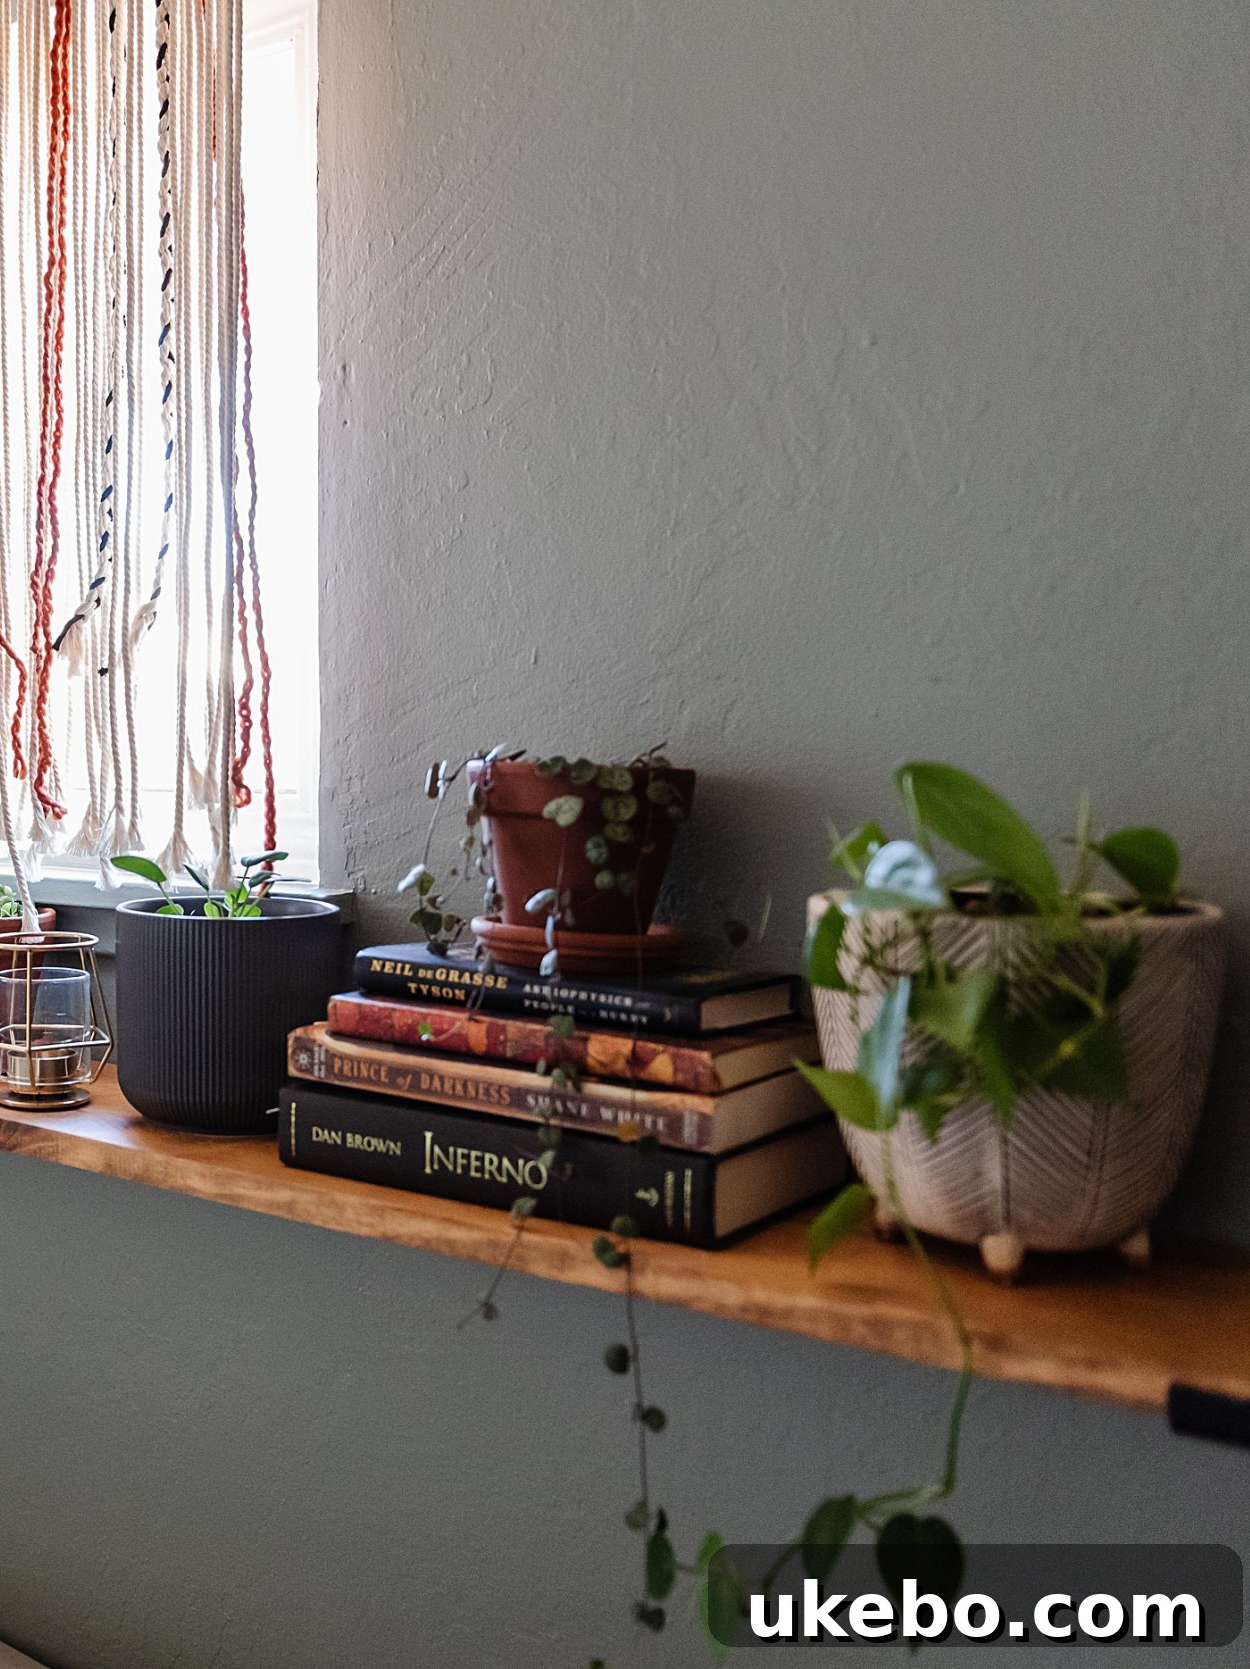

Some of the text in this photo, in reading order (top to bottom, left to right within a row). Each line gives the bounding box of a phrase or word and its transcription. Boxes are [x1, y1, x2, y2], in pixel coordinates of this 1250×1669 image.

[370, 959, 413, 976] NEIL
[407, 982, 466, 1000] TYSON
[333, 1056, 389, 1082] PRINCE
[396, 1074, 412, 1091] of
[420, 1073, 511, 1105] DARKNESS
[311, 1126, 548, 1190] DAN BROWN INFERNO
